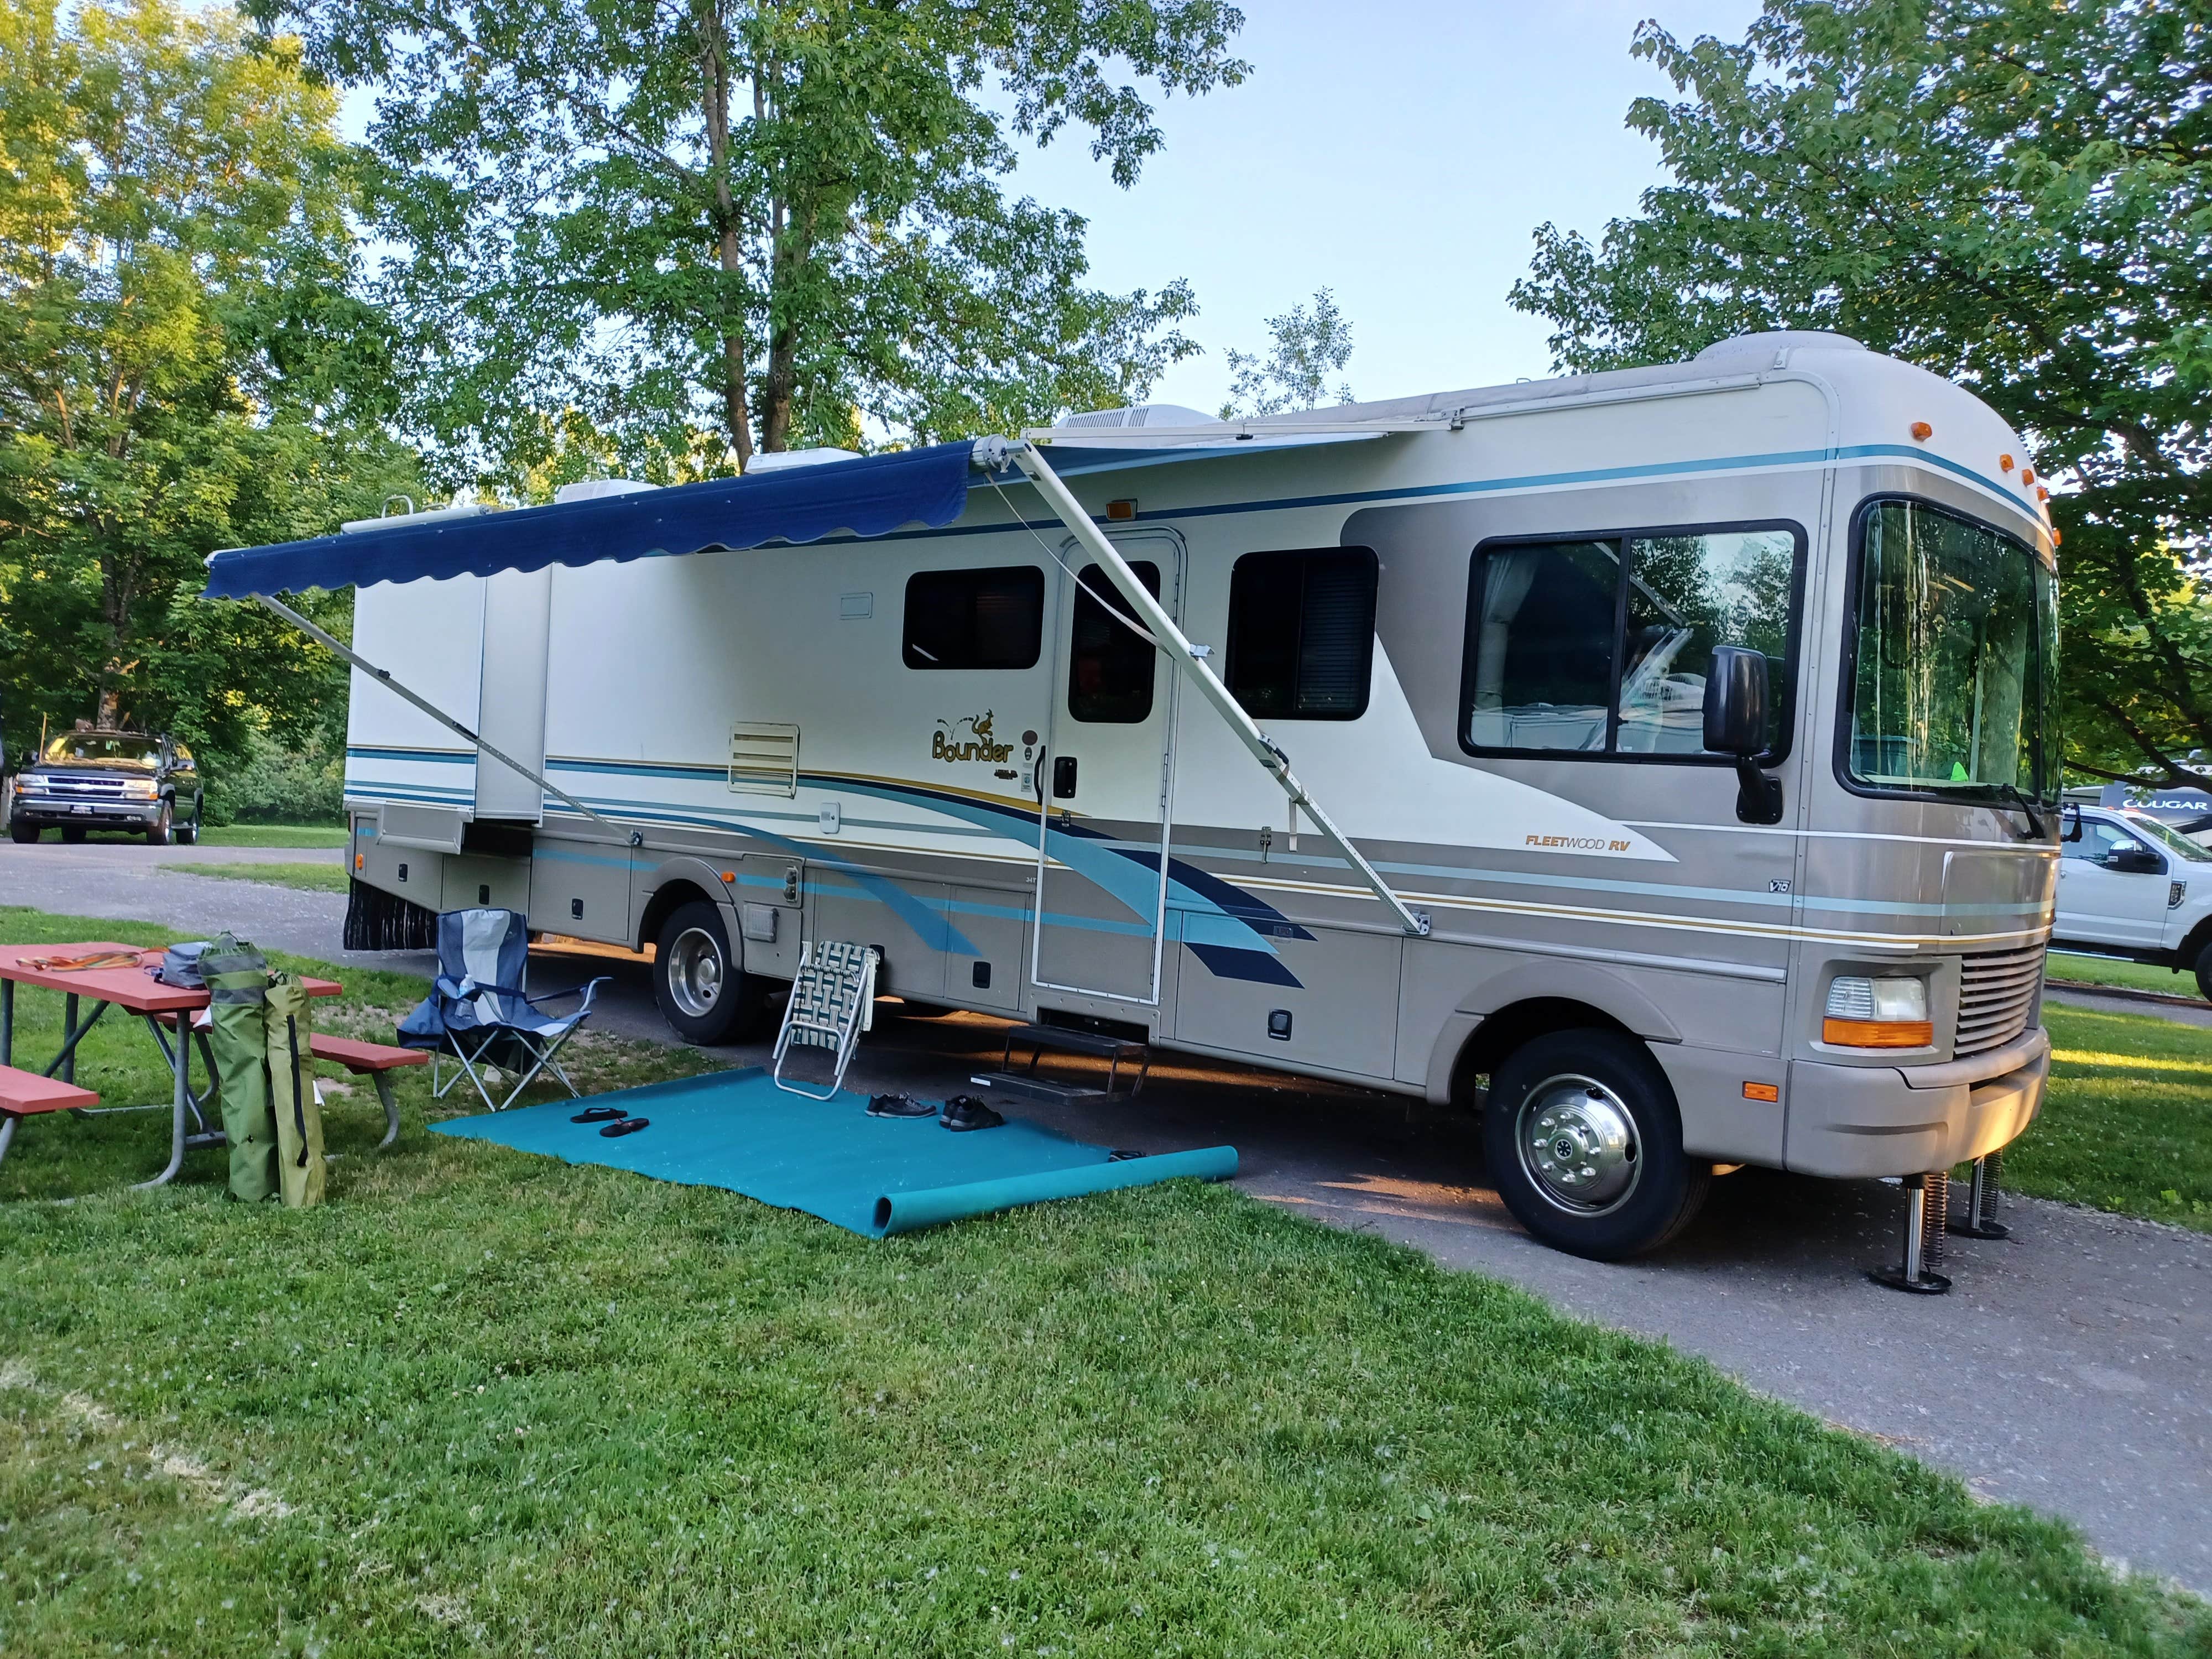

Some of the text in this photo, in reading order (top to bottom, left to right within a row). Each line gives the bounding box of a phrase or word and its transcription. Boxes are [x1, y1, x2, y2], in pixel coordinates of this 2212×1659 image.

[932, 731, 1014, 763] Bounder
[2122, 799, 2208, 810] COUGAR
[1526, 835, 1631, 851] FLEETWOOD RV
[1770, 882, 1788, 892] V10
